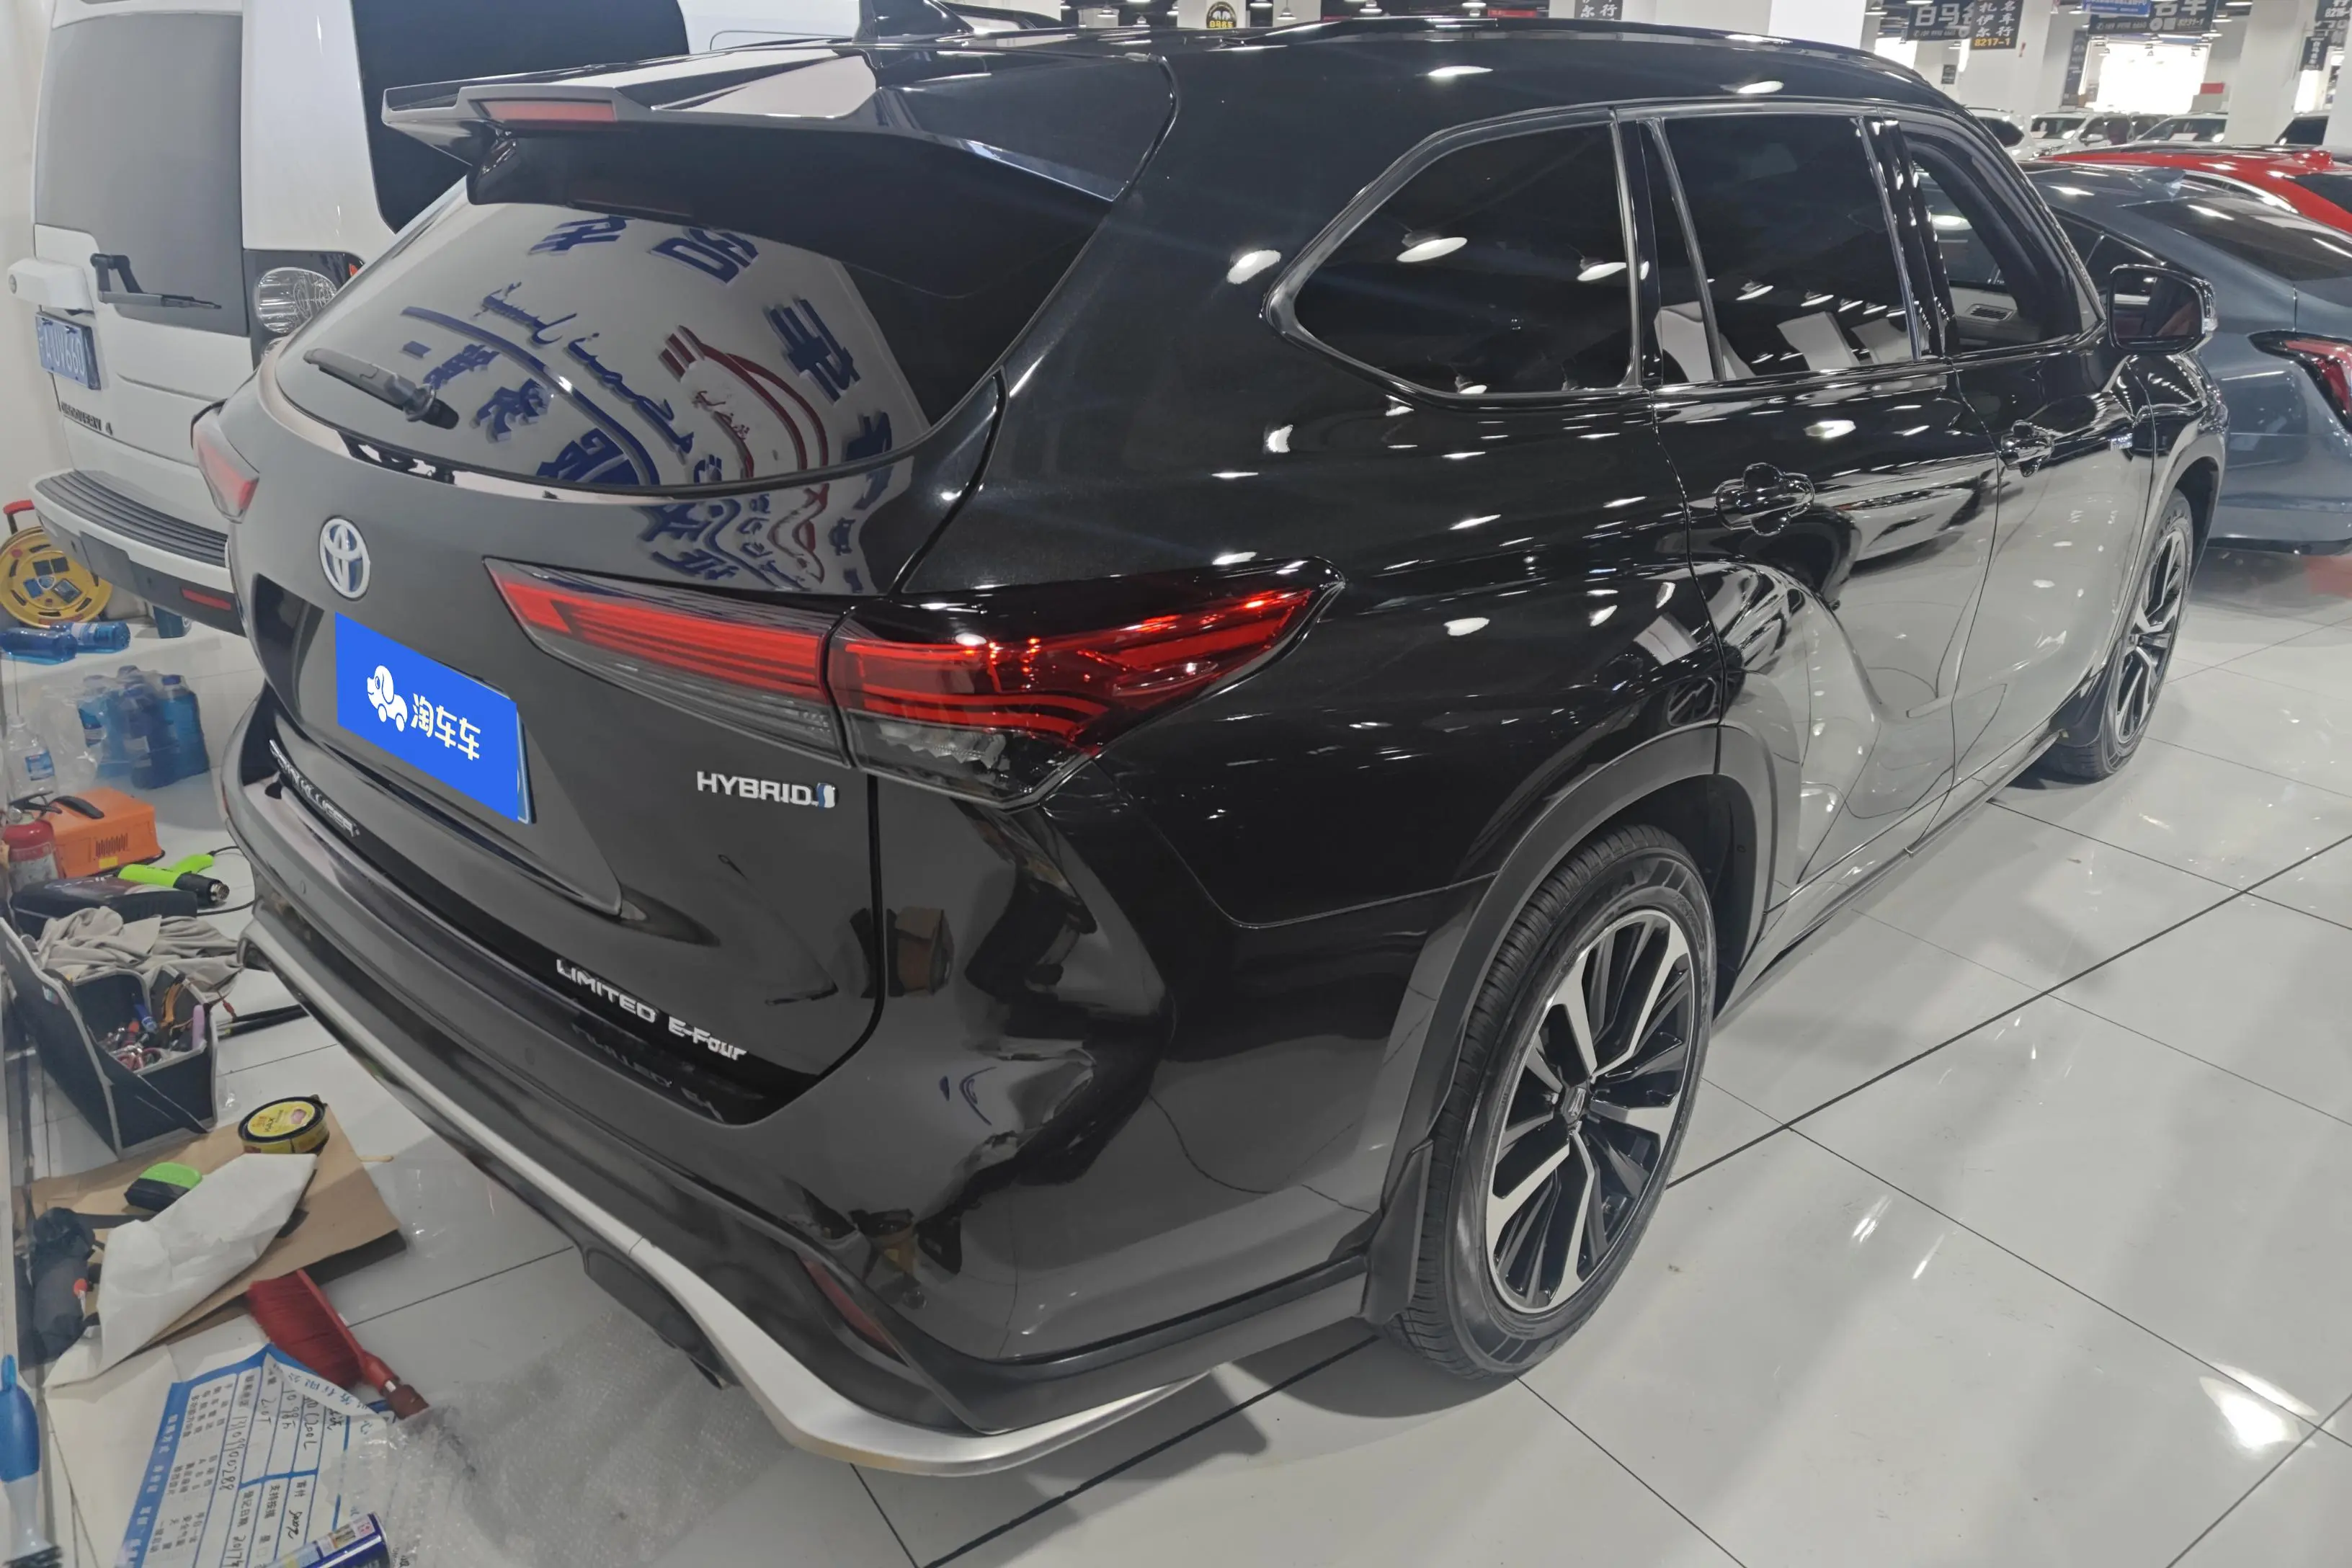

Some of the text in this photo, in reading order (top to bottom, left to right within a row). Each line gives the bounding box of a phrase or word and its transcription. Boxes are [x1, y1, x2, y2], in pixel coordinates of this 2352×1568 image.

[1974, 38, 2010, 47] 8217-1
[696, 770, 813, 806] HYBRID
[556, 958, 659, 1023] LIMITED
